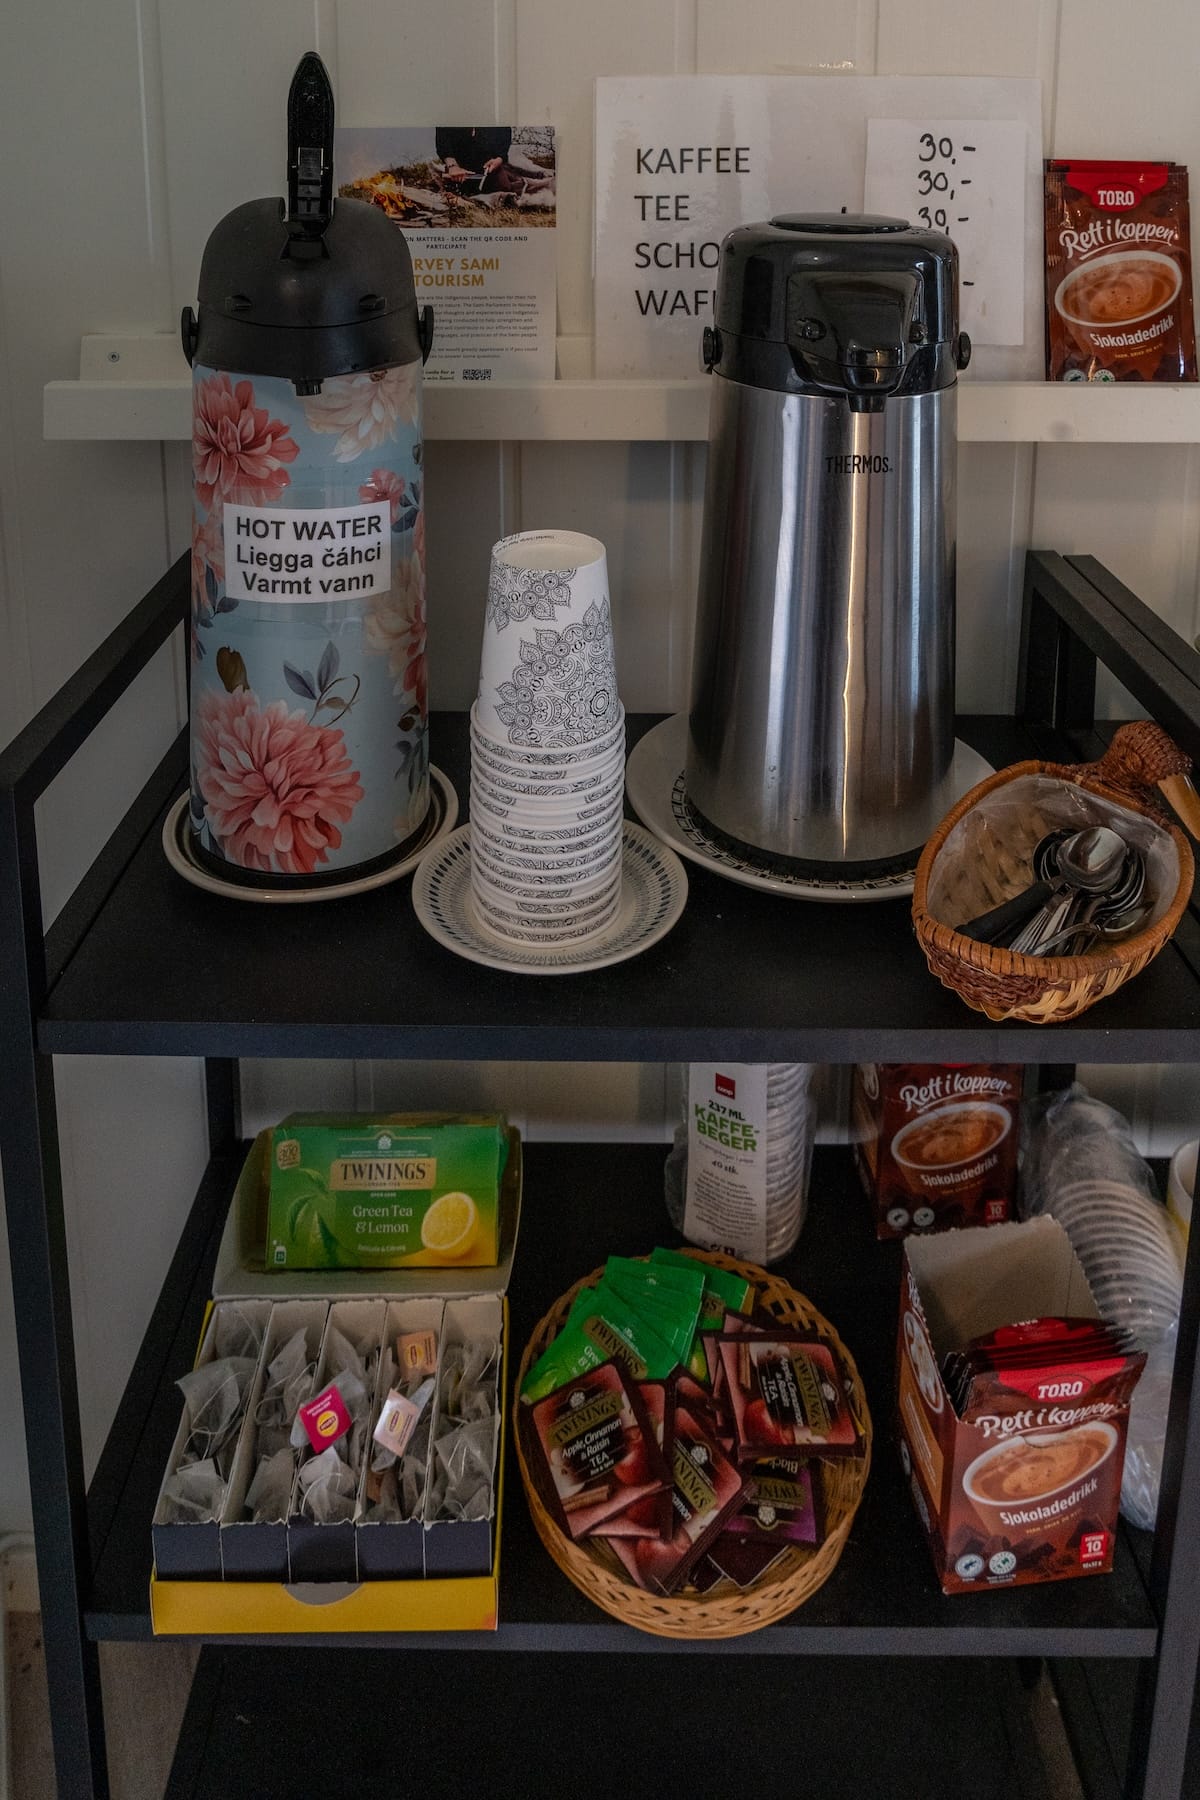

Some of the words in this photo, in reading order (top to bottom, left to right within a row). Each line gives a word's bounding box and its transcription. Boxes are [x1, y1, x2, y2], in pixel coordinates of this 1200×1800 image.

[636, 147, 750, 174] KAFFEE
[918, 133, 976, 165] 30,-
[917, 170, 971, 199] 30,-
[634, 195, 690, 221] TEE
[1097, 190, 1135, 206] TORO
[1059, 221, 1104, 259] Rett
[1106, 222, 1113, 240] i
[1114, 218, 1175, 245] koppen
[414, 258, 455, 270] RVEY
[460, 258, 500, 270] SAMI
[635, 242, 720, 269] SCHO
[414, 274, 485, 287] TOURISM
[635, 290, 717, 316] WAF
[1089, 314, 1175, 348] Sjokoladedrikk
[825, 455, 889, 474] THERMOS
[236, 516, 285, 540] HOT
[293, 515, 382, 541] WATER
[236, 544, 313, 573] Liegga
[322, 542, 382, 568] čáhci
[242, 571, 312, 595] Varmt
[319, 573, 375, 594] vann
[899, 1076, 944, 1112] Rett
[945, 1075, 952, 1095] i
[953, 1072, 1007, 1096] koppen
[694, 1103, 760, 1137] KAFFE-
[708, 1099, 727, 1114] 237
[728, 1108, 746, 1121] ML
[697, 1119, 757, 1152] BEGER
[340, 1162, 426, 1180] TWININGS
[920, 1155, 999, 1187] Sjokoladedrikk
[352, 1205, 389, 1217] Green
[391, 1204, 413, 1217] Tea
[355, 1221, 366, 1234] &
[368, 1222, 409, 1233] Lemon
[592, 1321, 641, 1375] TWININGS
[767, 1379, 778, 1401] TEA
[794, 1354, 820, 1429] TWININGS
[1038, 1380, 1083, 1399] TORO
[554, 1399, 619, 1442] TWININGS
[584, 1418, 622, 1446] Cinnamon
[976, 1410, 1034, 1438] Rett
[1036, 1411, 1046, 1425] i
[1047, 1400, 1118, 1425] koppen
[586, 1437, 611, 1457] Raisin
[589, 1451, 610, 1467] TEA
[999, 1477, 1098, 1526] Sjokoladedrikk
[1086, 1540, 1102, 1553] 10
